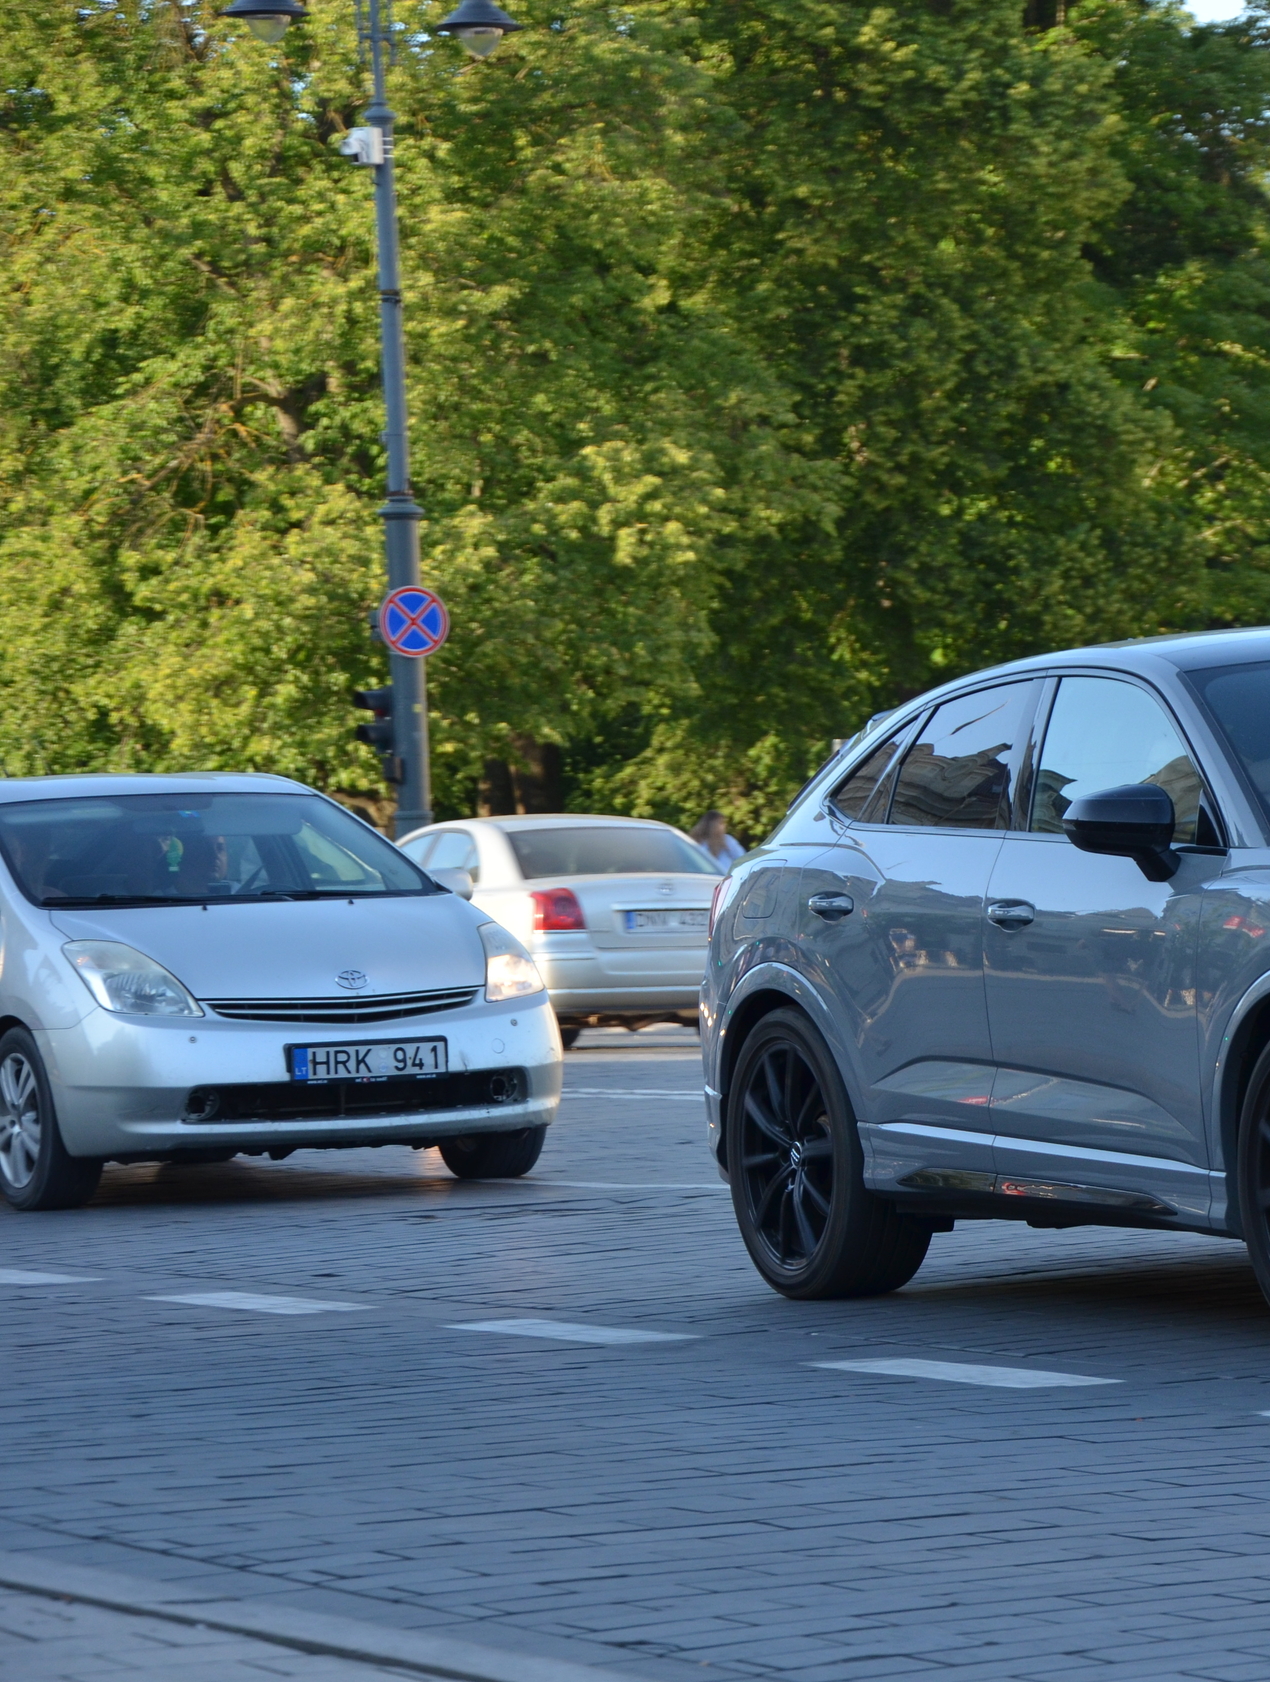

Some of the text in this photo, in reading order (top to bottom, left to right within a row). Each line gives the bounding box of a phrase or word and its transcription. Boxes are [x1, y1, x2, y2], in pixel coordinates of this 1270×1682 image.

[312, 1045, 439, 1076] HRK 941
[295, 1066, 307, 1076] LT
